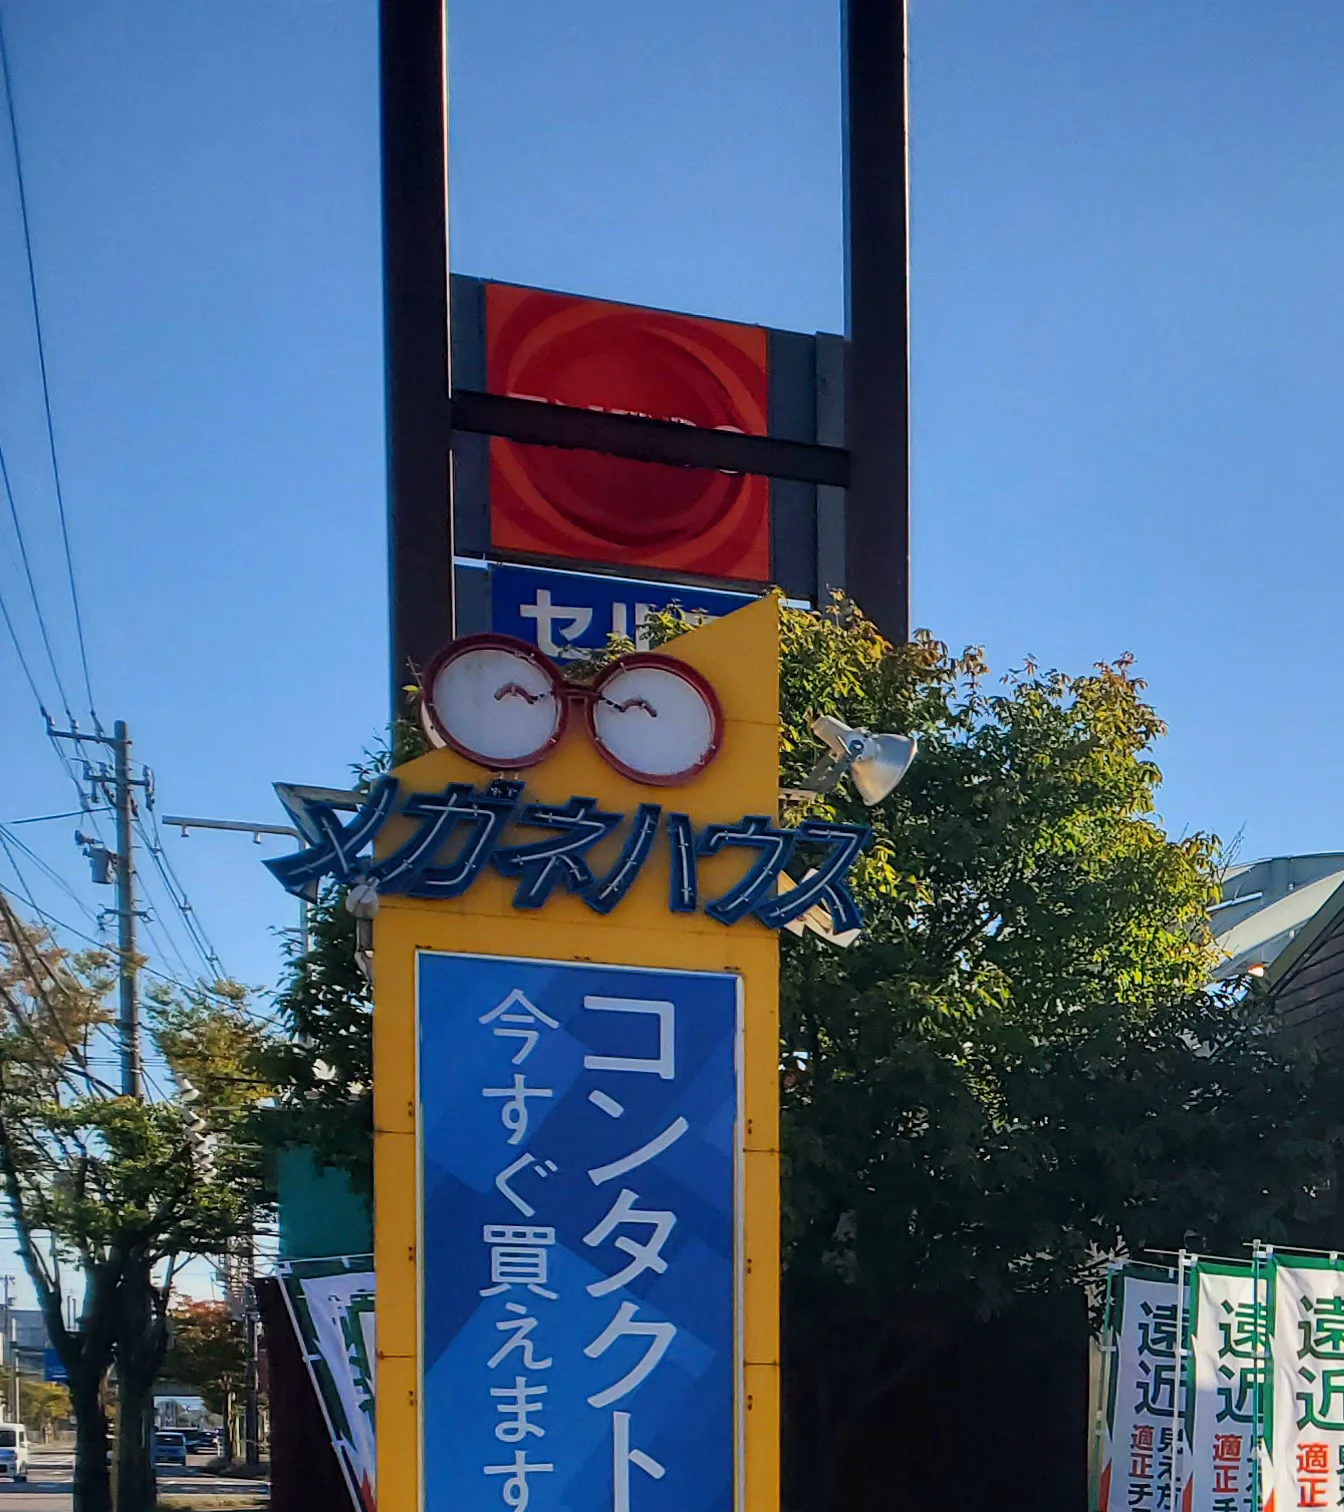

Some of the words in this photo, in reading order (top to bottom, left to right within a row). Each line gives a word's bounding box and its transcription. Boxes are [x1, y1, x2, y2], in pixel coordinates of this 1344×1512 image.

[262, 776, 873, 935] メガネハウス
[1134, 1300, 1190, 1418] 遠近
